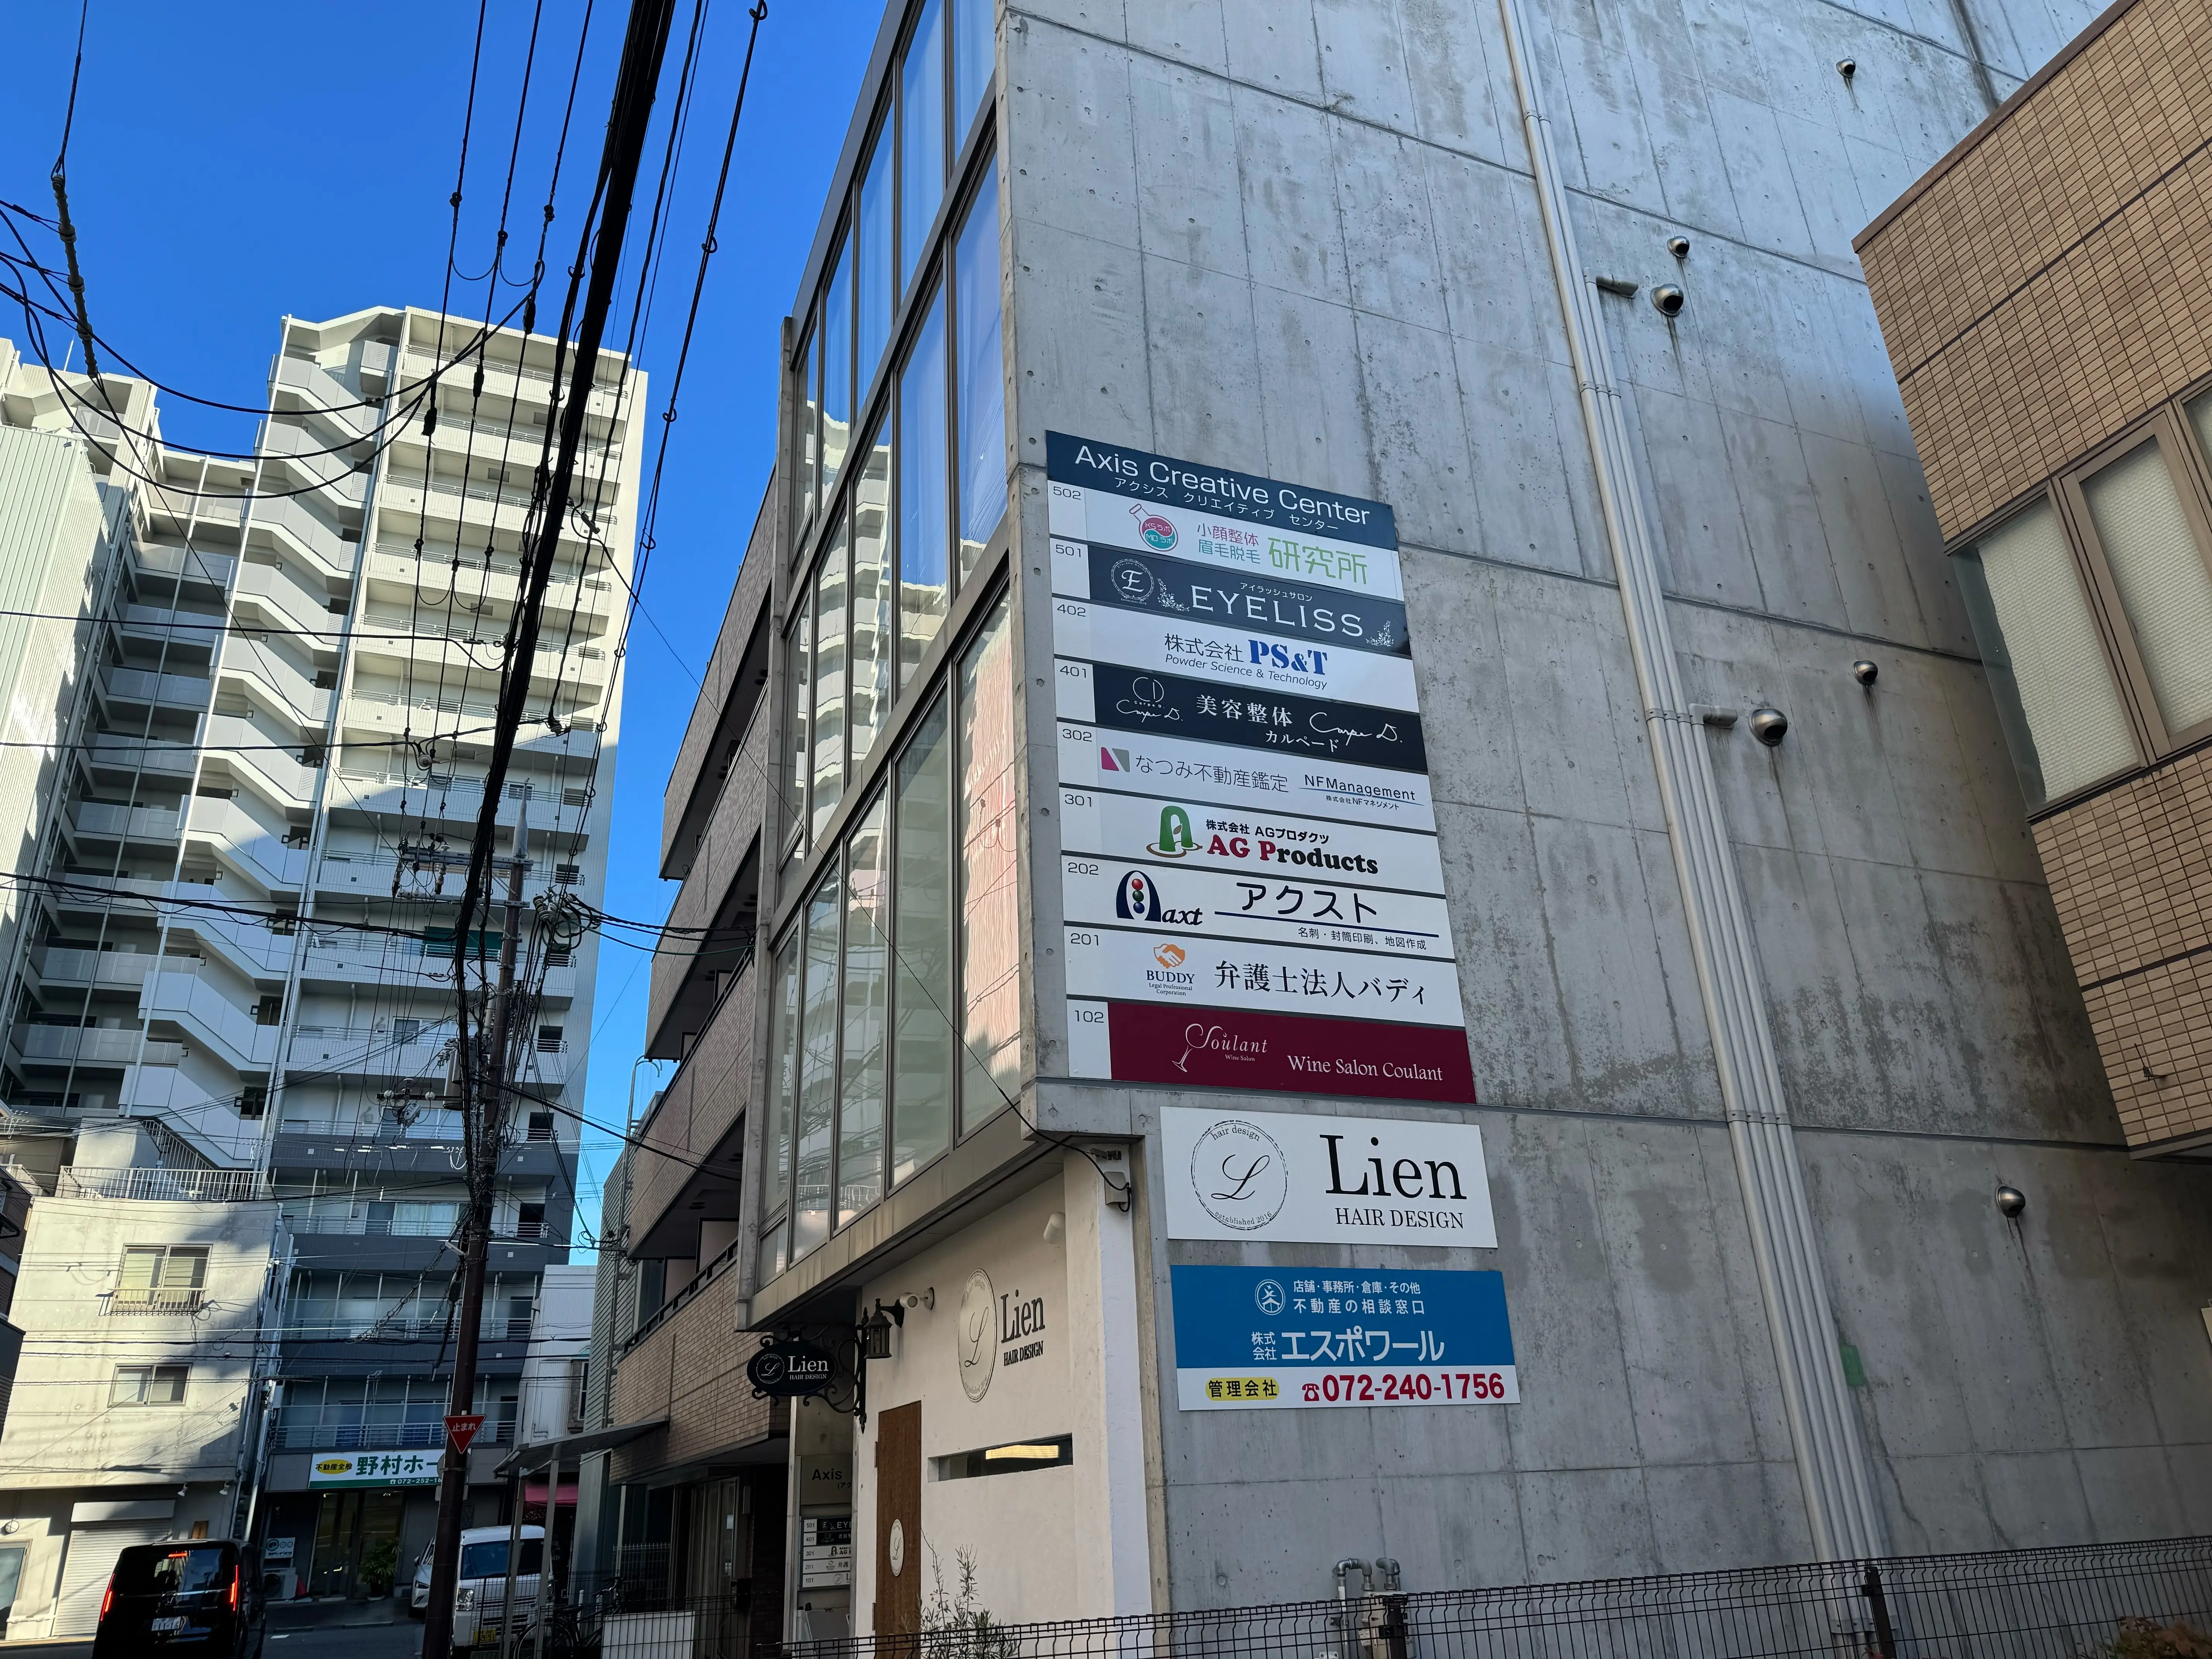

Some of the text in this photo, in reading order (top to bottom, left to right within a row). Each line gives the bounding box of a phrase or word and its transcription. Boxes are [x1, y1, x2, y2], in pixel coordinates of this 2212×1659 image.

[1053, 486, 1081, 500] 502
[1075, 445, 1370, 525] Axis Creative Center
[1115, 477, 1338, 530] アクシス クリエイティブ センター
[1197, 523, 1259, 547] 小顔整体
[1056, 544, 1082, 558] 501
[1199, 539, 1261, 564] 眉毛脱毛
[1267, 537, 1367, 585] 研究所
[1121, 570, 1144, 592] E
[1240, 582, 1312, 602] アイラッシュサロン
[1057, 604, 1086, 617] 402
[1191, 585, 1363, 637] EYELISS
[1164, 633, 1328, 675] 株式会社 PS&T
[1060, 665, 1087, 678] 401
[1165, 654, 1327, 690] Powder Science & Technology
[1196, 694, 1293, 727] 美容整体
[1062, 728, 1092, 742] 302
[1265, 730, 1339, 752] カルペード
[1135, 755, 1290, 793] なつみ不動産鑑定
[1304, 774, 1415, 801] NFManagement
[1065, 794, 1093, 807] 301
[1326, 795, 1400, 811] 株式会社NFマネジメント
[1205, 819, 1329, 844] 株式会社 AGプロダクツ
[1207, 834, 1379, 874] AG Products
[1068, 862, 1099, 875] 202
[1236, 882, 1377, 923] アクスト
[1070, 933, 1099, 946] 201
[1297, 927, 1427, 950] 名刺・封筒印刷、地図作成
[1146, 970, 1195, 984] BUDDY
[1214, 960, 1425, 1005] 弁護士法人バディ
[1075, 1010, 1104, 1024] 102
[1287, 1055, 1443, 1081] Wine Salon Coulant
[1210, 1125, 1260, 1142] hair design
[1211, 1154, 1270, 1200] L
[1319, 1134, 1467, 1200] Lien
[1214, 1211, 1272, 1225] established 2016
[1334, 1207, 1464, 1230] HAIR DESIGN
[1000, 1289, 1046, 1344] Lien
[1293, 1298, 1425, 1315] 不動産の相談窓口
[964, 1306, 989, 1368] L
[1251, 1331, 1276, 1346] 株式
[1281, 1325, 1445, 1362] エスポワール
[788, 1355, 829, 1372] Lien
[1003, 1340, 1044, 1367] HAIR DESIGN
[1252, 1346, 1277, 1361] 会社
[1208, 1379, 1278, 1398] 管理会社
[1322, 1373, 1505, 1402] 072-240-1756
[451, 1422, 476, 1432] 止まれ
[315, 1463, 353, 1471] 不動産全般
[812, 1468, 842, 1480] Axis
